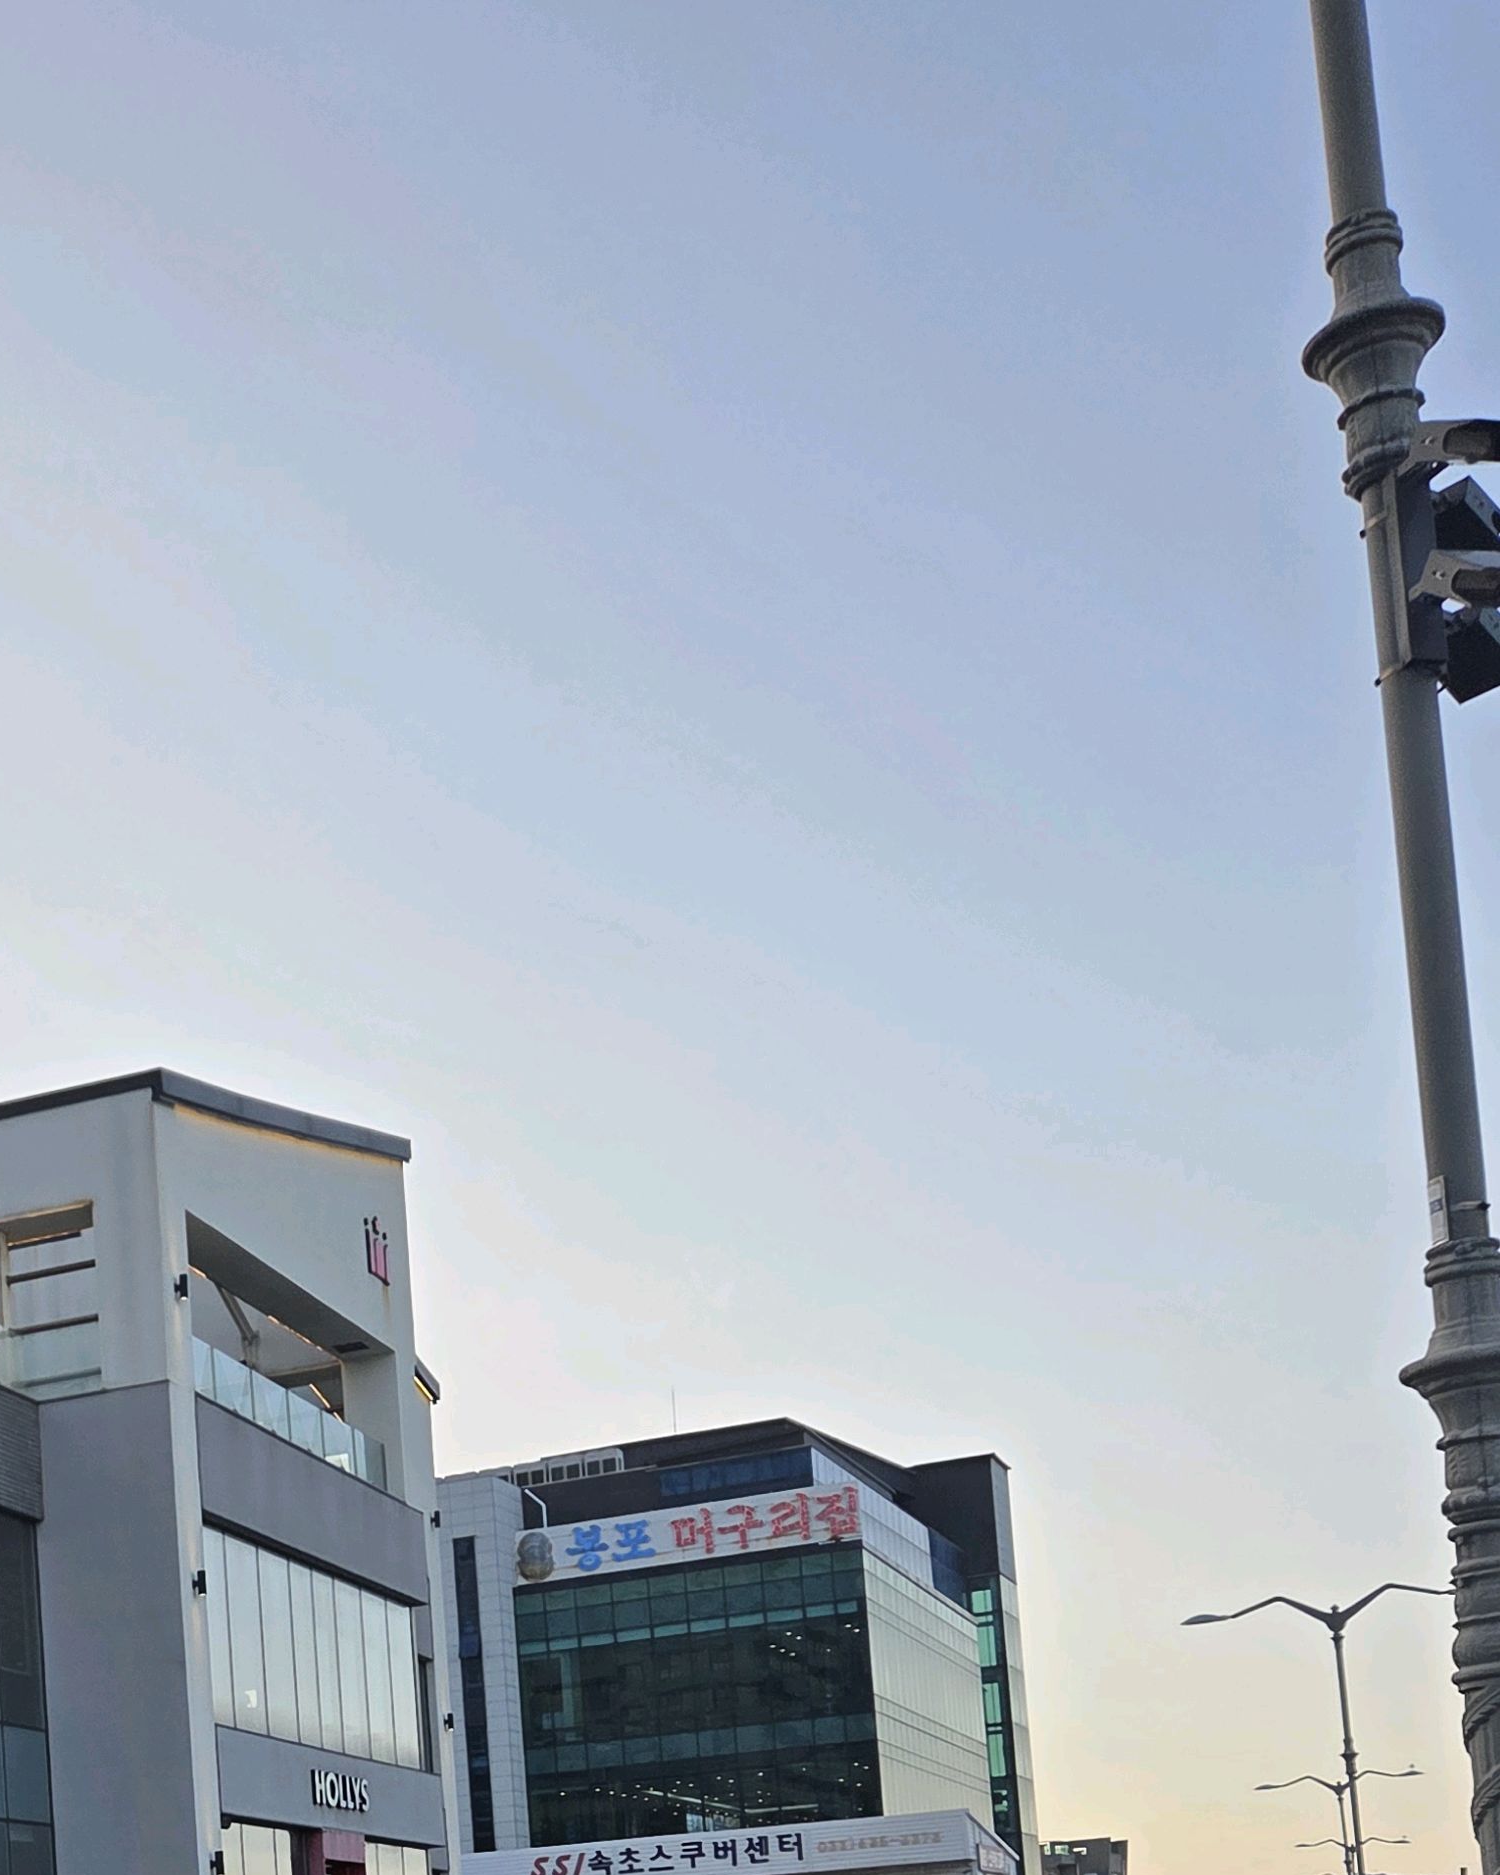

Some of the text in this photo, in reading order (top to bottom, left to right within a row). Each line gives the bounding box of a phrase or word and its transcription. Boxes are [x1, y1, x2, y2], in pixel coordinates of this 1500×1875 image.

[566, 1486, 859, 1572] 봉포 머구리집
[312, 1769, 369, 1812] HOLLYS
